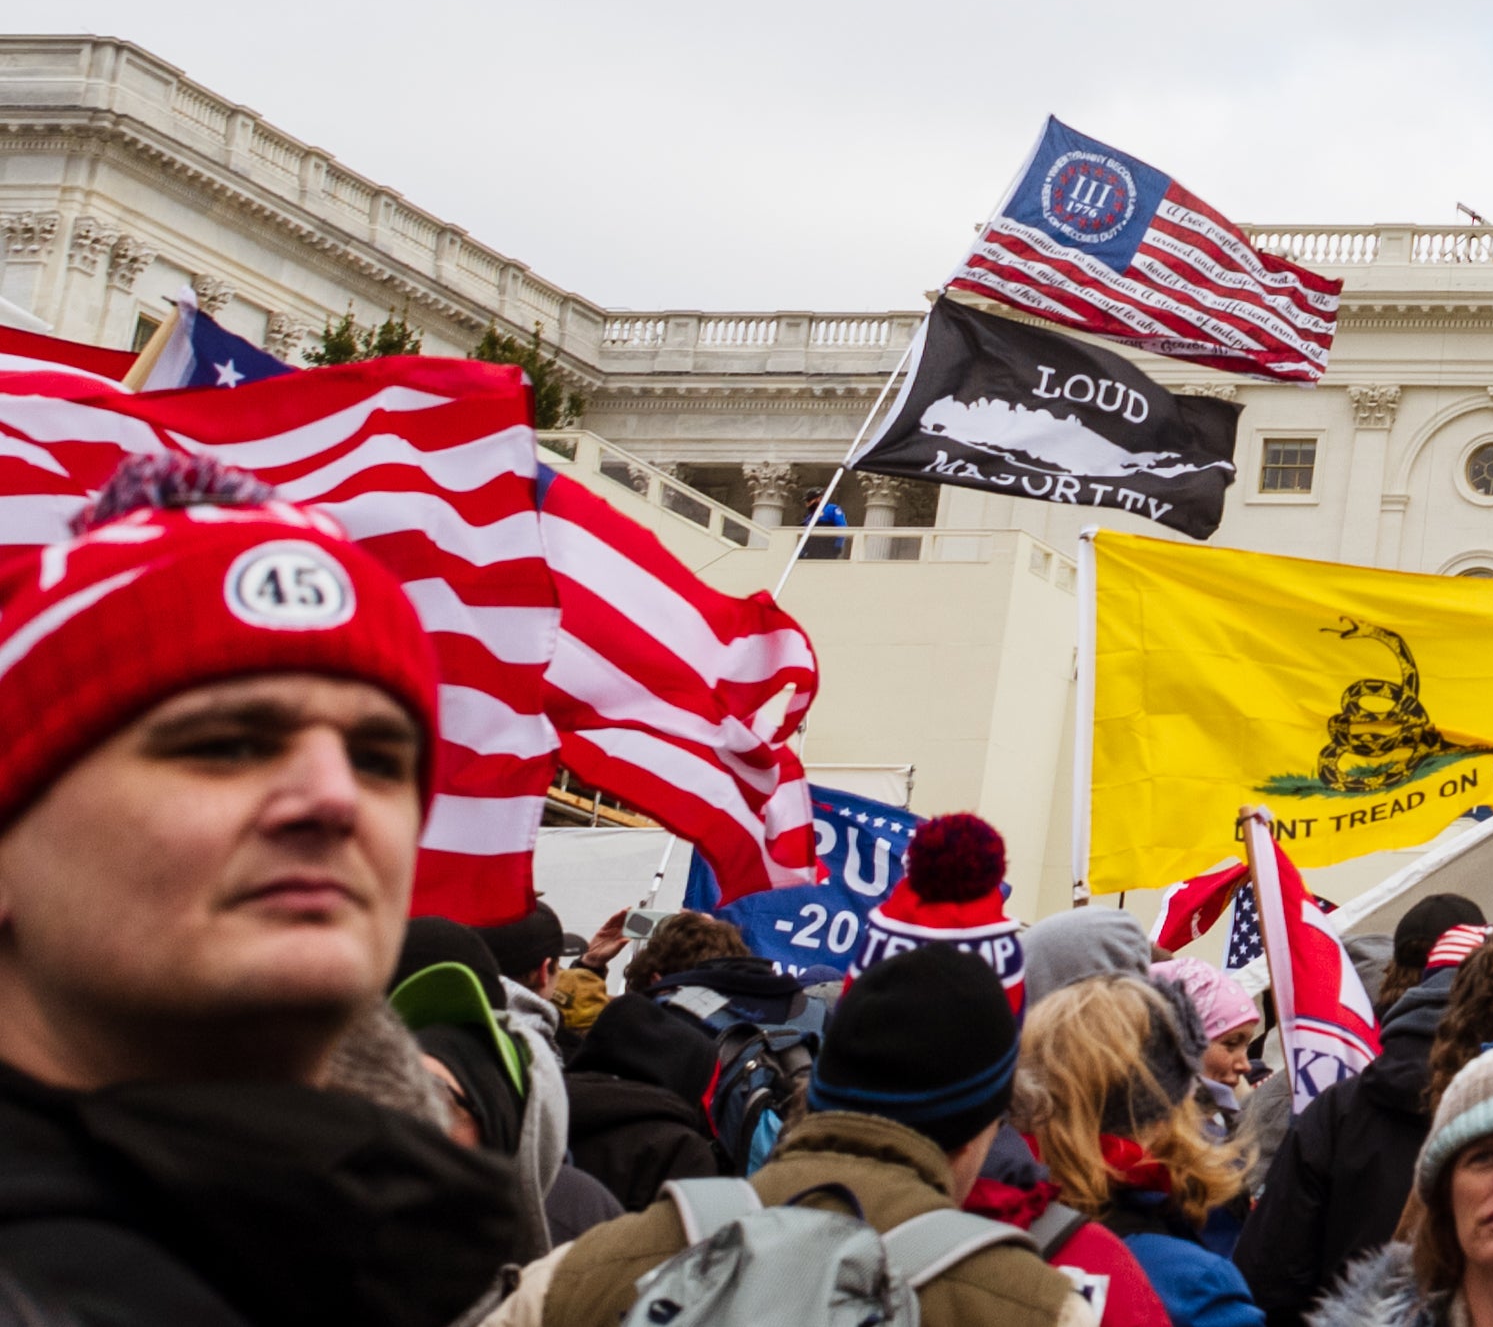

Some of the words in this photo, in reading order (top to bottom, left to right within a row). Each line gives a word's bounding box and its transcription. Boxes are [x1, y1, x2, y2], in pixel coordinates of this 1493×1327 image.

[1066, 200, 1098, 218] 1776
[1069, 174, 1113, 208] III
[1152, 234, 1193, 258] armed
[1193, 252, 1215, 274] and
[1166, 204, 1182, 217] A
[1179, 210, 1205, 230] free
[1205, 225, 1241, 252] people
[1240, 251, 1268, 283] ought
[1010, 284, 1044, 307] Their
[1086, 260, 1139, 293] maintain
[1195, 310, 1210, 332] of
[1140, 257, 1179, 287] should
[1211, 296, 1271, 326] sufficient
[1300, 340, 1323, 359] And
[1032, 365, 1149, 424] LOUD
[257, 564, 325, 608] 45
[1329, 791, 1426, 832] TREAD
[1438, 768, 1478, 798] ON
